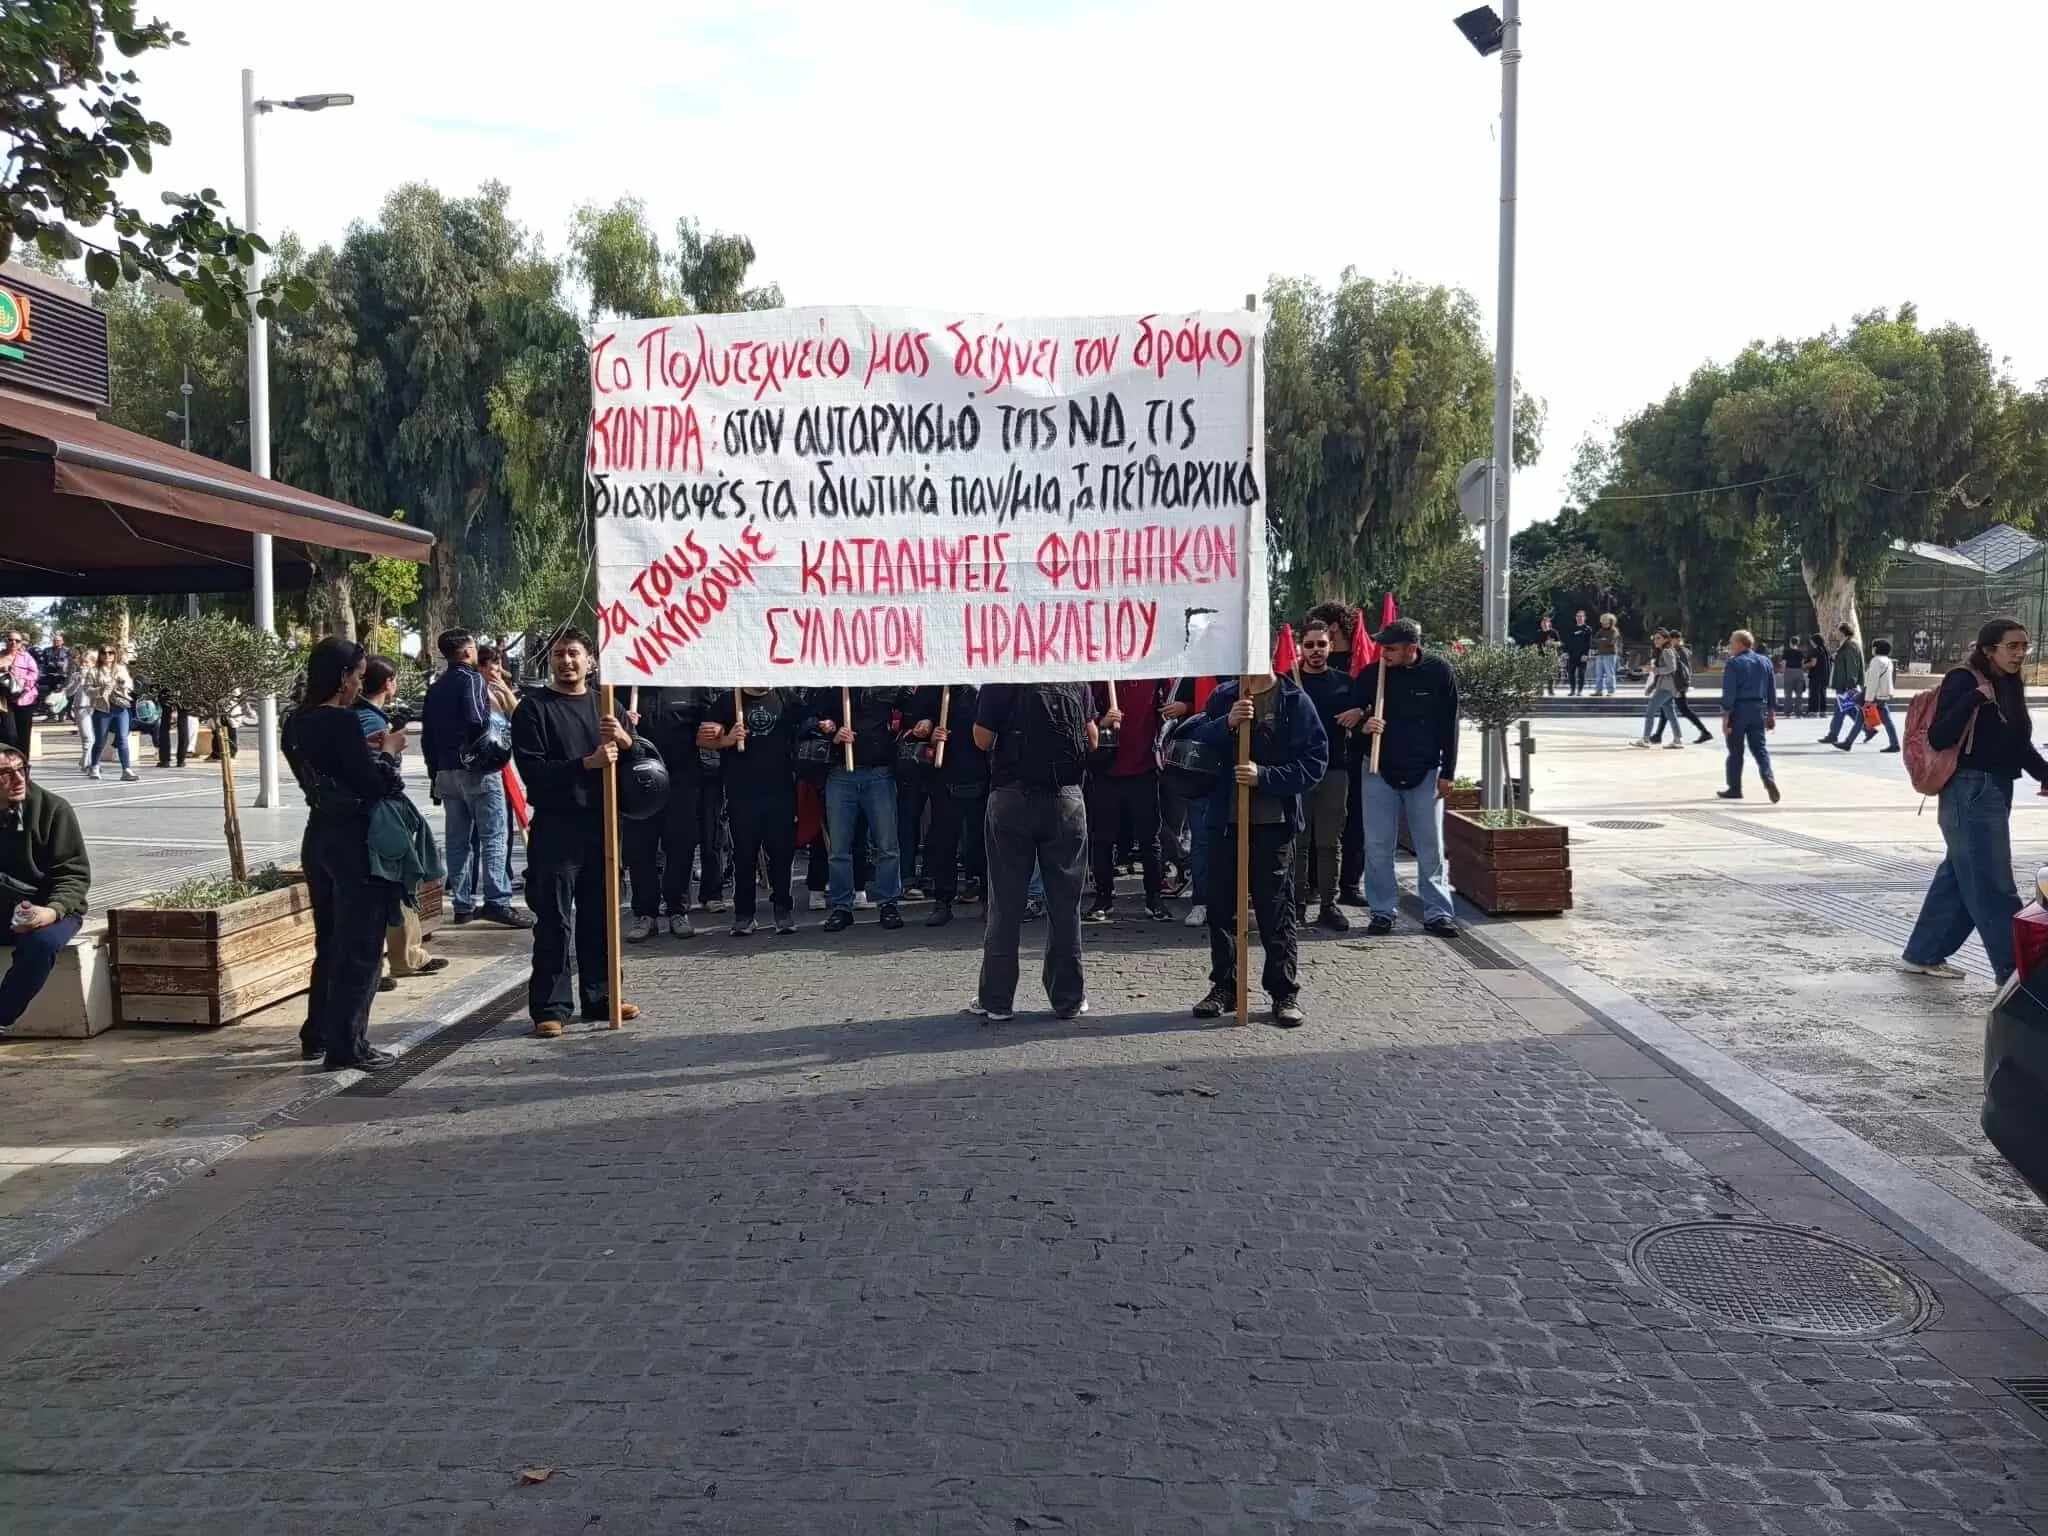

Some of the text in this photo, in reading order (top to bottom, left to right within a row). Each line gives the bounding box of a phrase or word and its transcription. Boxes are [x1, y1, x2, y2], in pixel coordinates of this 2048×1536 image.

[638, 318, 850, 401] Πολυτεχνείο
[864, 325, 931, 390] μας
[946, 320, 1059, 394] δείχνει
[1074, 334, 1120, 377] τον
[1133, 314, 1242, 380] δρόμο
[723, 408, 785, 457] στον
[996, 404, 1057, 453] της
[1145, 398, 1196, 450] τις
[756, 479, 798, 521] τα
[809, 460, 938, 519] ιδιωτικά
[630, 529, 708, 608] τους
[801, 523, 1237, 596] ΚΑΤΑΛΗΨΕΙΣ ΦΟΙΤΗΤΙΚΩΝ
[766, 597, 1157, 668] ΣΥΛΛΟΓΩΝ ΗΡΑΚΛΕΙΟΥ
